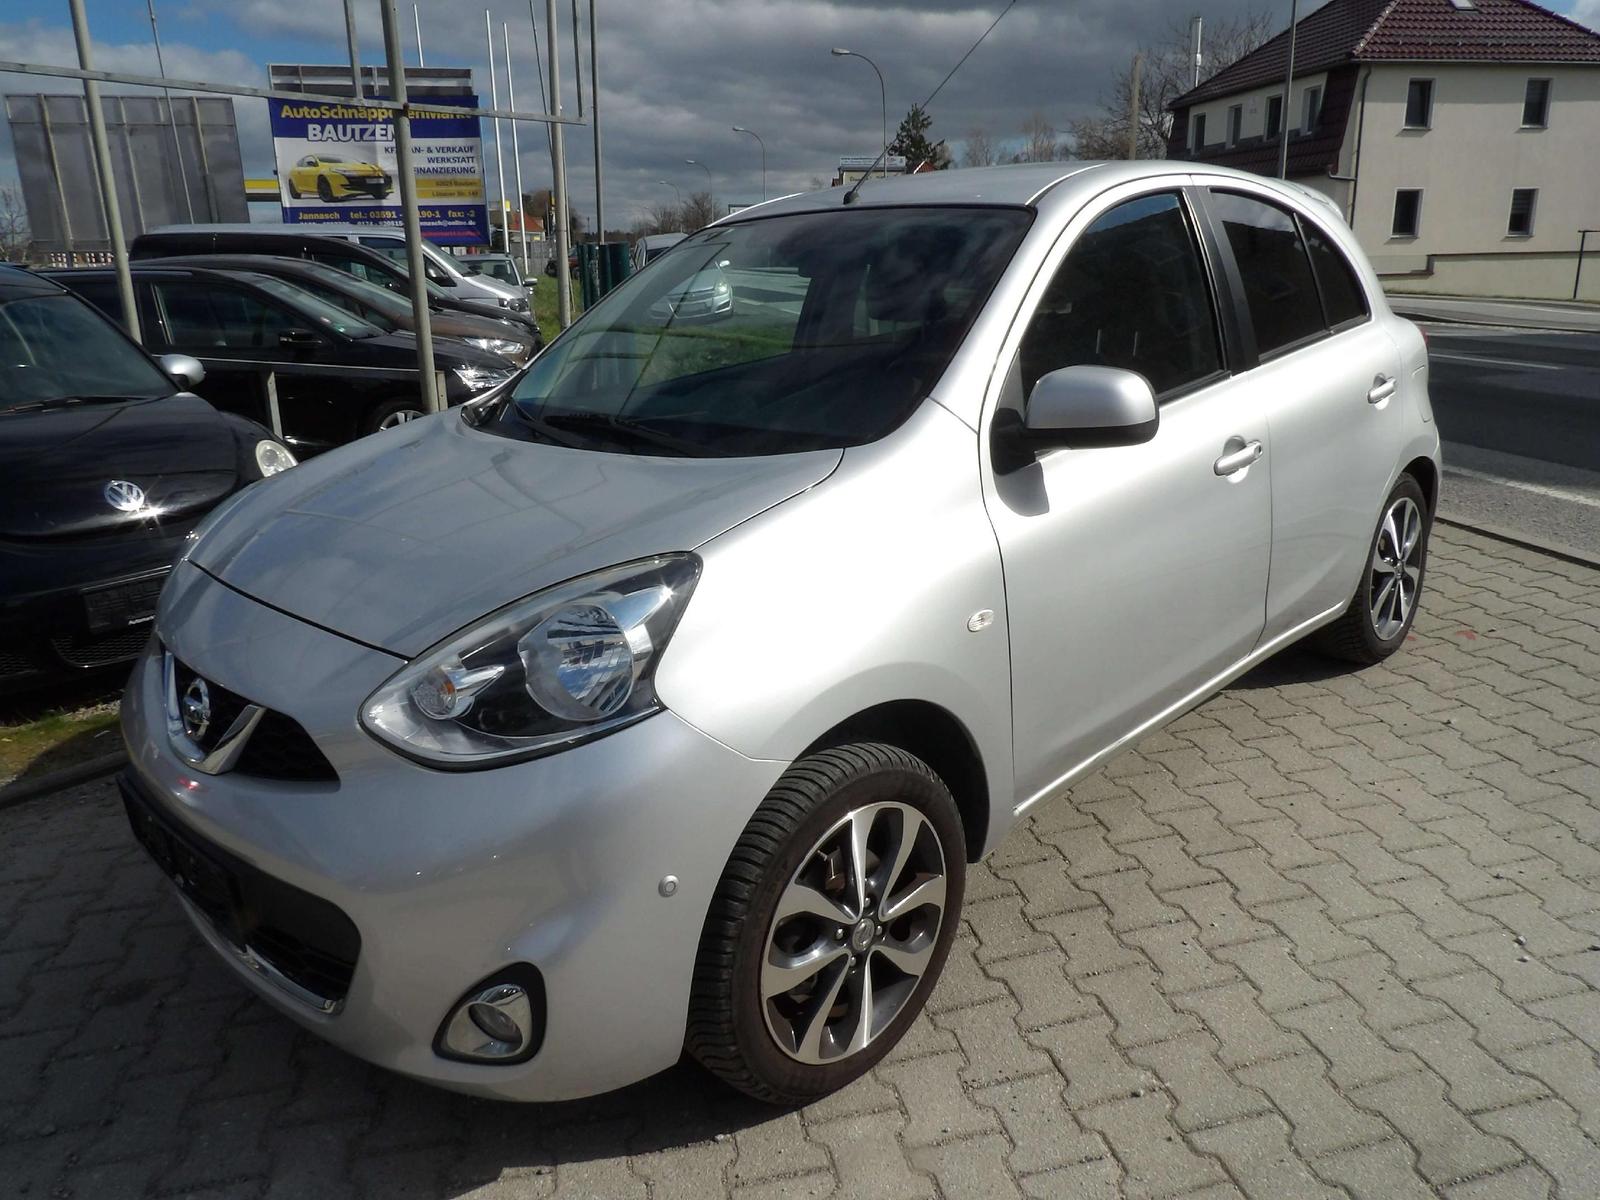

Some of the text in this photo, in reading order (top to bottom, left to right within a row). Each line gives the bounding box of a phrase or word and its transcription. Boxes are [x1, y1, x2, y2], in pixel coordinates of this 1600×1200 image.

[435, 146, 475, 154] VERKAUF
[427, 156, 476, 164] WERKSTATT
[299, 211, 340, 220] Jannasch
